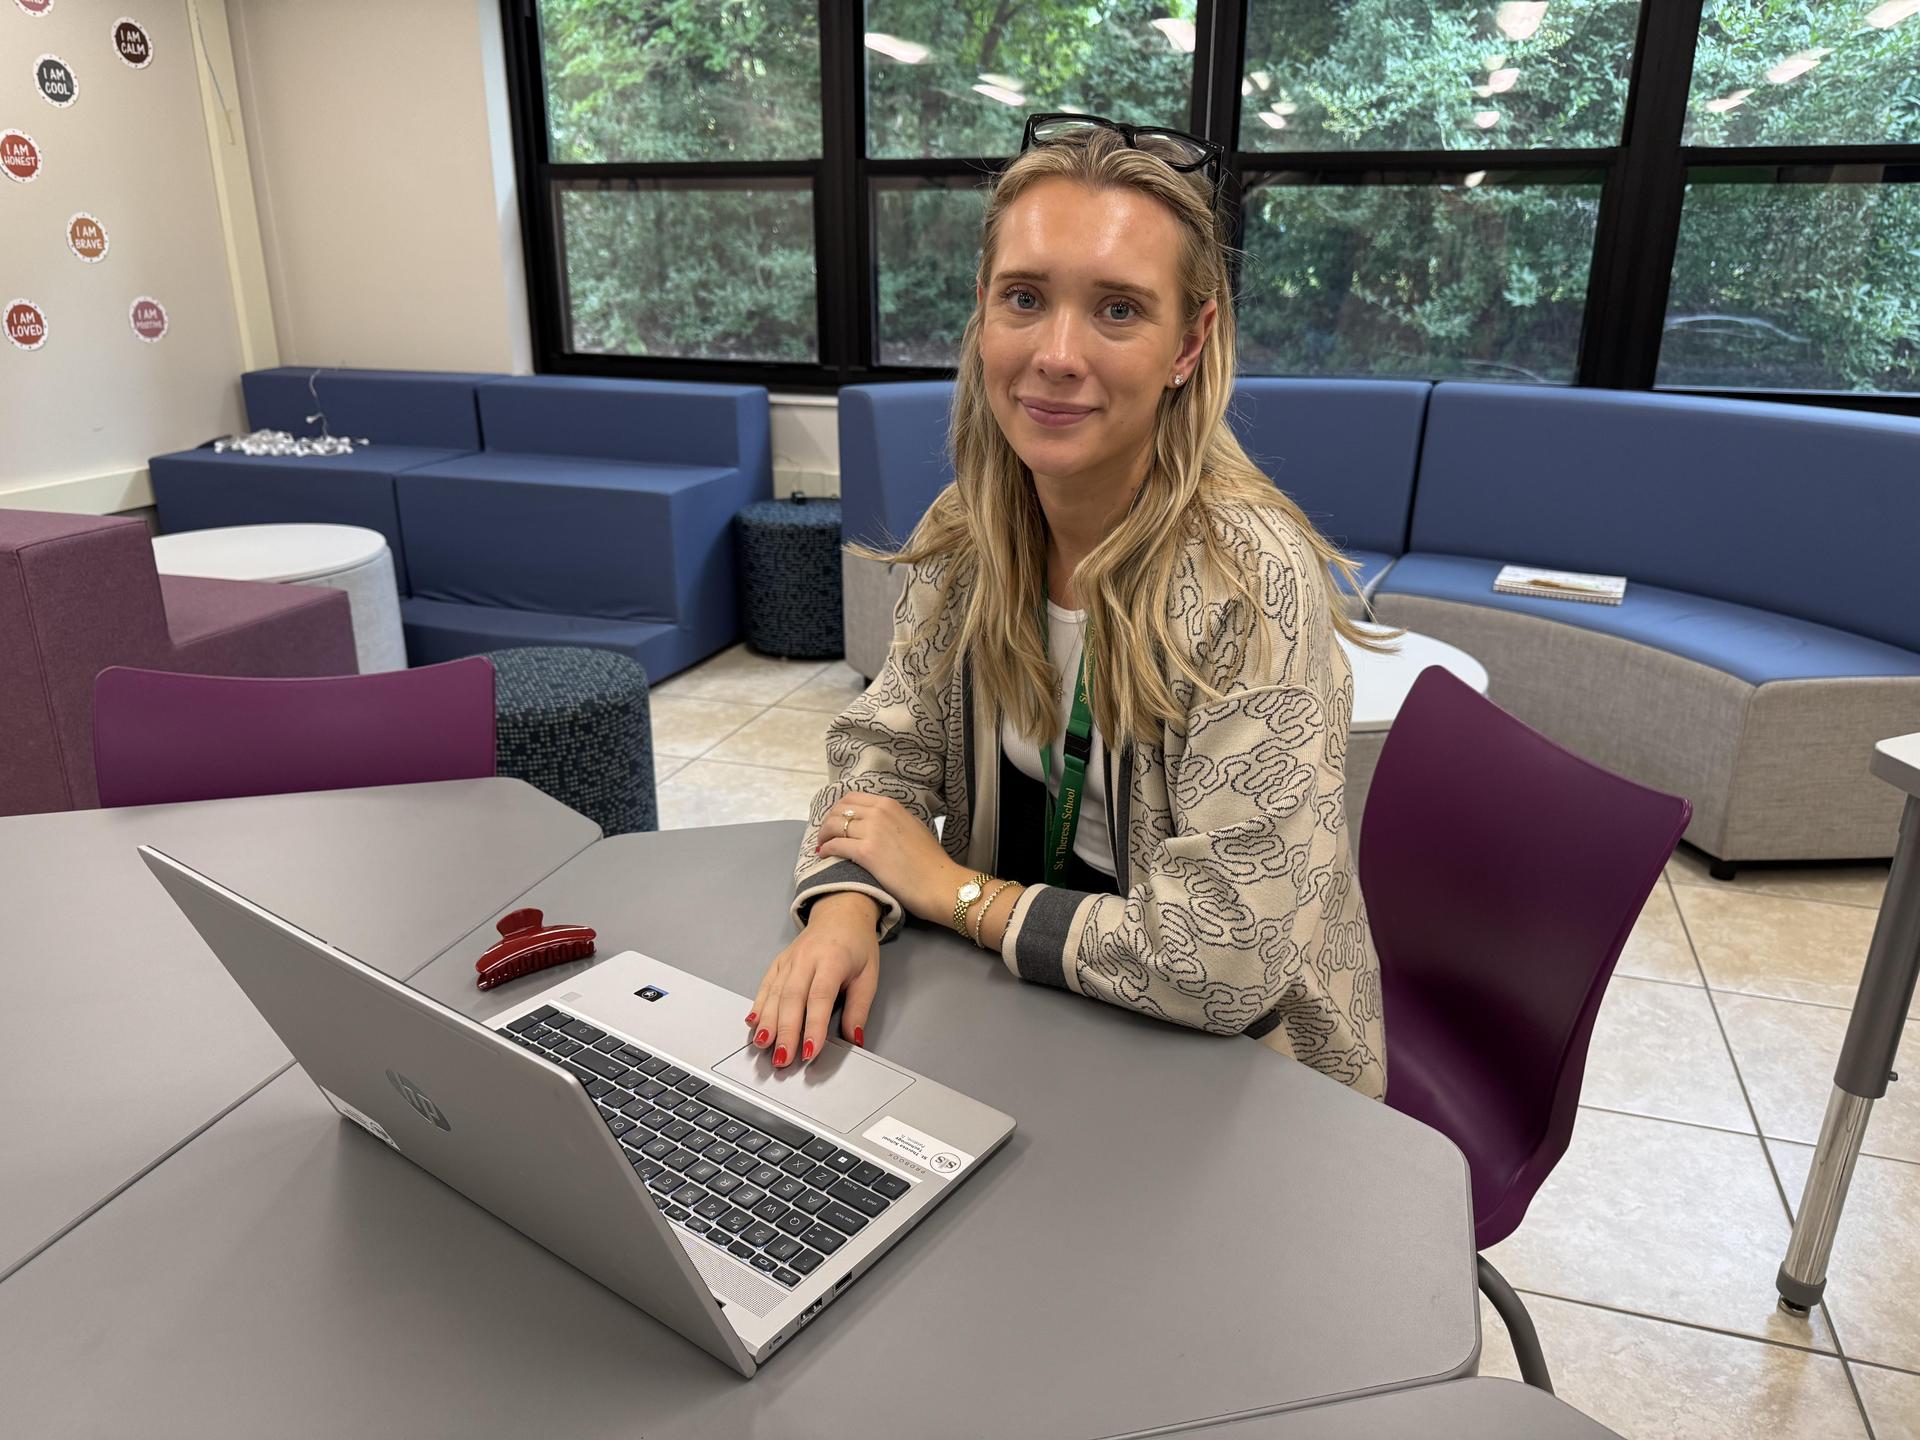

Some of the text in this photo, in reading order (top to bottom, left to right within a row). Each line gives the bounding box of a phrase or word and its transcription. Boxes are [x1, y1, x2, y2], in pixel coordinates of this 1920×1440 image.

[127, 31, 141, 43] AM
[121, 43, 146, 55] CALM
[50, 68, 65, 81] AM
[45, 82, 70, 95] COOL
[13, 145, 29, 155] AM
[4, 156, 35, 166] HONEST
[83, 226, 97, 237] AM
[75, 239, 102, 249] BRAVE
[20, 312, 35, 323] AM
[144, 309, 157, 319] AM
[11, 325, 42, 337] LOVED
[1054, 787, 1076, 871] St. Theresa School
[881, 1135, 898, 1145] School
[895, 1136, 923, 1153] Technology
[899, 1144, 919, 1157] Theresa
